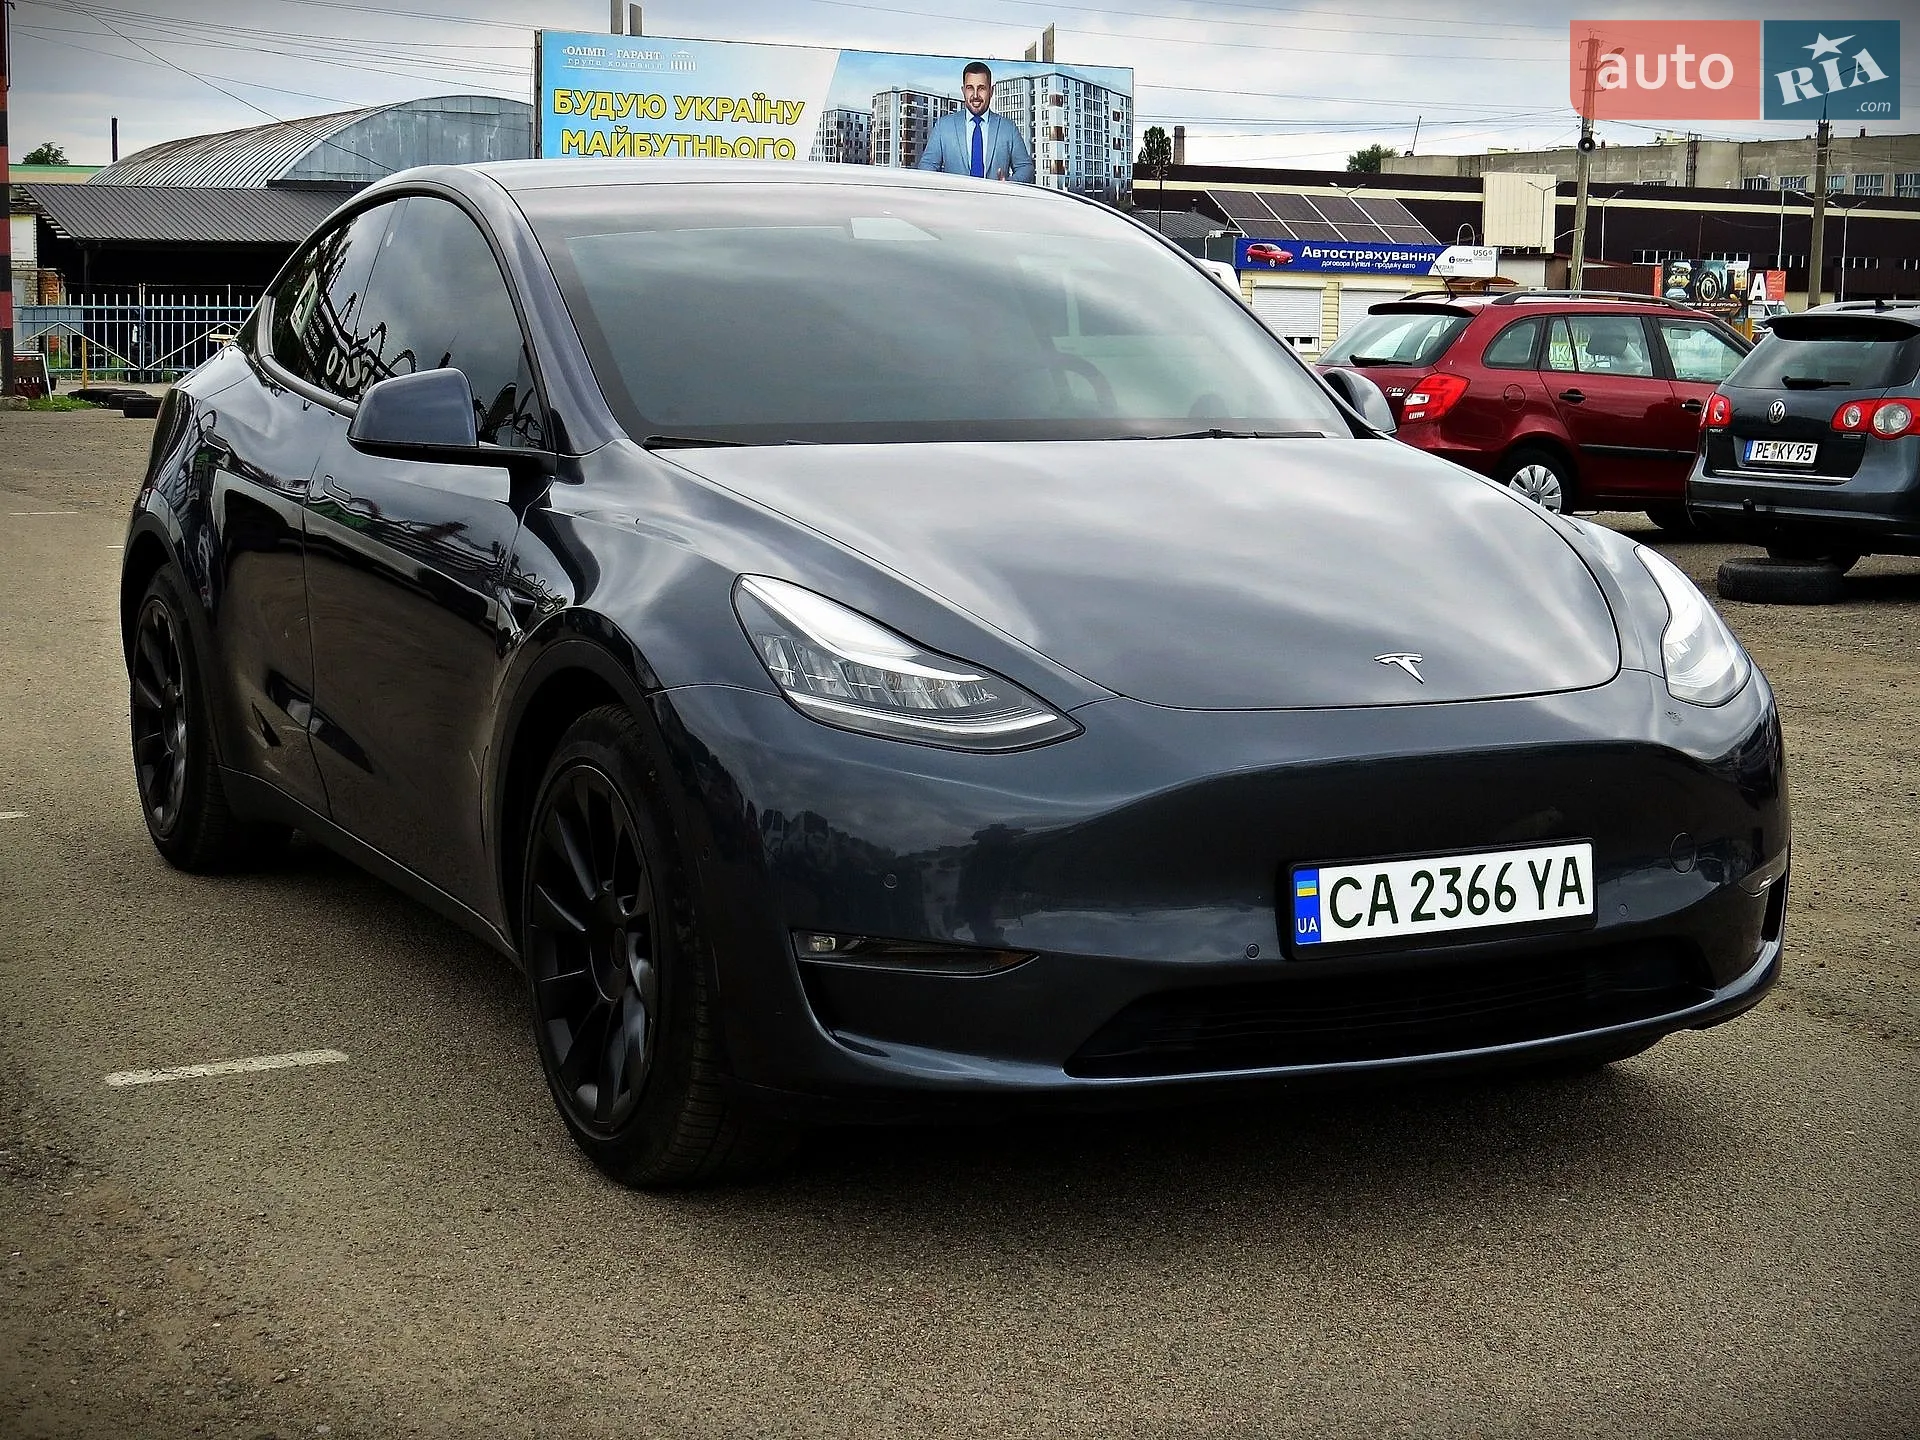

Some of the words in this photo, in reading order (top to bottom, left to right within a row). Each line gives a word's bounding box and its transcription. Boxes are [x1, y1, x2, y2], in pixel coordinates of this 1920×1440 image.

[553, 89, 667, 121] БУДУЮ
[674, 92, 805, 126] УКРАЇНУ
[561, 125, 796, 160] МАЙБУТНЬОГО
[1301, 246, 1436, 262] Автострахування
[1756, 443, 1771, 458] PE
[1777, 443, 1795, 459] KY
[1796, 445, 1813, 461] 95
[1329, 873, 1399, 929] CA
[1411, 862, 1517, 922] 2366
[1528, 856, 1585, 911] YA
[1298, 917, 1319, 934] UA
